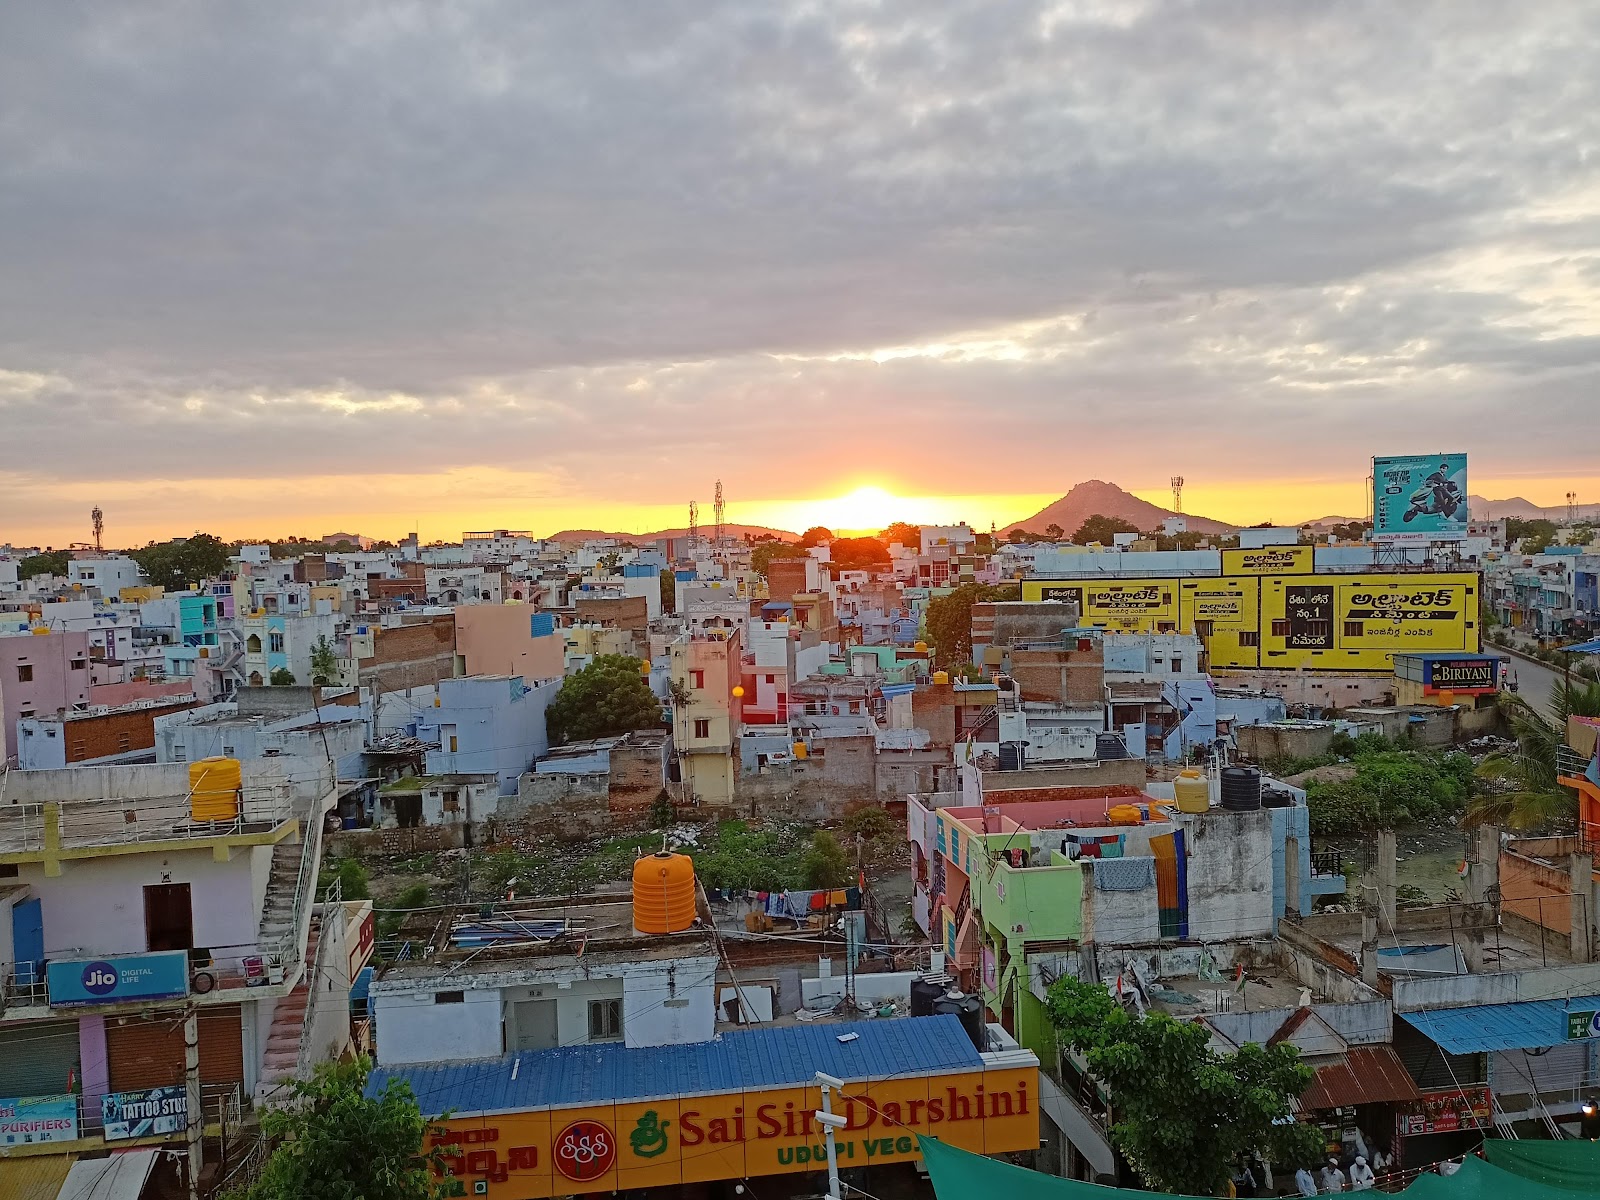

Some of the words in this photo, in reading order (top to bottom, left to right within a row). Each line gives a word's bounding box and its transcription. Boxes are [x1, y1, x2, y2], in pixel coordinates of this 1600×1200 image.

[1441, 666, 1492, 681] BIRIYANI
[85, 969, 116, 987] Jio
[121, 968, 153, 977] DIGITAL
[1570, 1017, 1589, 1025] TABLET
[120, 1092, 144, 1103] HARRY
[121, 1101, 161, 1120] TATTOO
[679, 1107, 747, 1147] Sai
[756, 1102, 827, 1139] Sir
[842, 1080, 1031, 1132] Darshini
[1, 1118, 72, 1134] PURIFIERS
[560, 1133, 608, 1164] SSS
[777, 1141, 854, 1165] UDUPI
